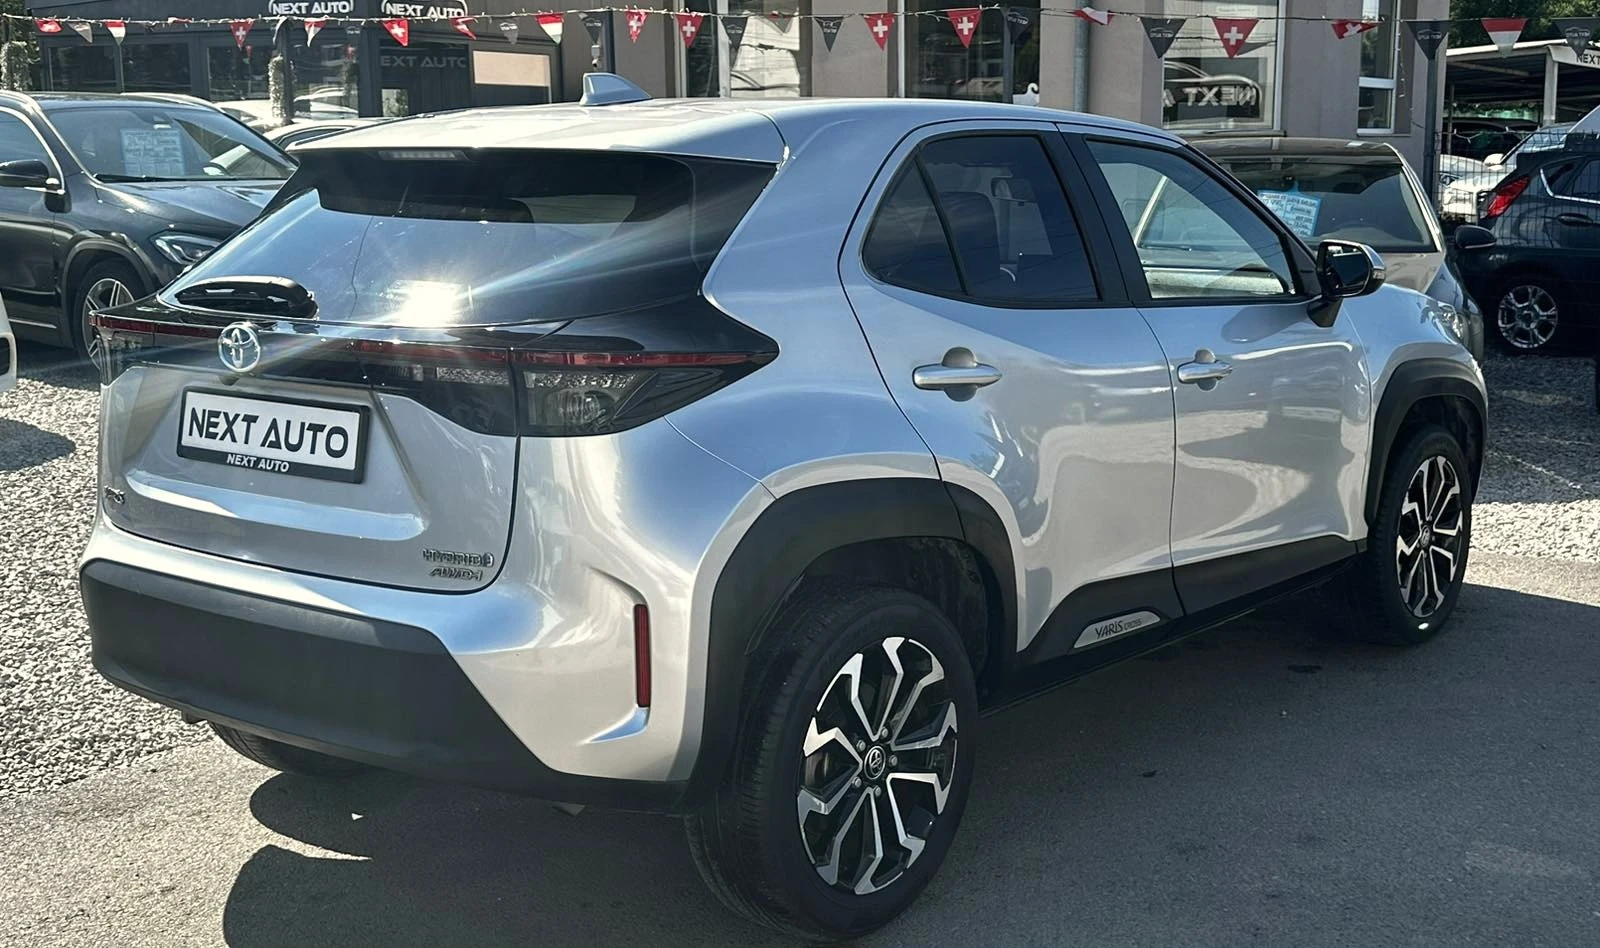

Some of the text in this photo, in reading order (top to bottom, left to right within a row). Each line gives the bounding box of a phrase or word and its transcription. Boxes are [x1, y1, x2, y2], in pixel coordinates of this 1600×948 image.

[272, 0, 350, 15] NEXT AUTO
[386, 3, 466, 18] NEXT AUTO
[380, 55, 418, 68] EXT
[1577, 54, 1600, 65] NEXT
[188, 407, 349, 459] NEXT AUTO
[226, 453, 290, 473] NEXT AUTO
[422, 548, 482, 567] HYBRID
[1095, 620, 1123, 640] YARIS
